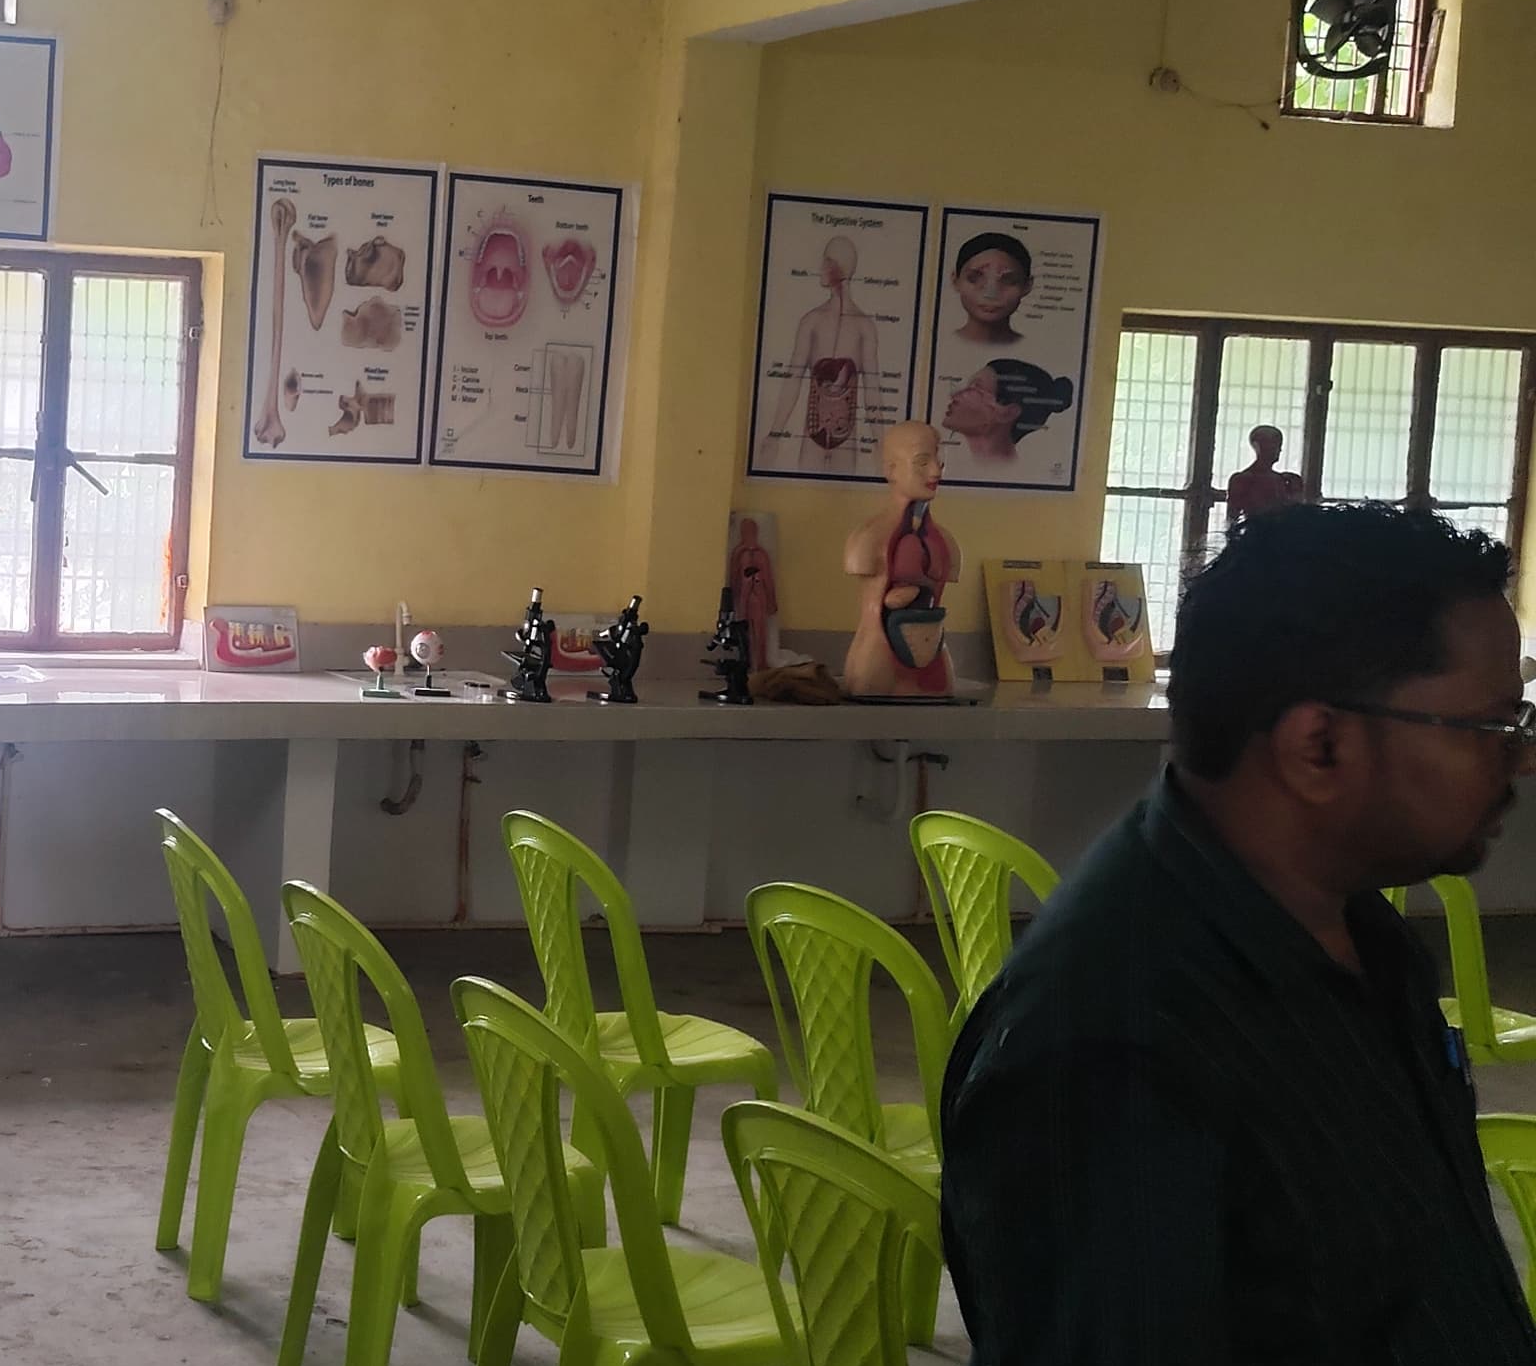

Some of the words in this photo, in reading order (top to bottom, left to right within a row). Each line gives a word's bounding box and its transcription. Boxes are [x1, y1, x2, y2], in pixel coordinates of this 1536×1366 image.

[323, 173, 344, 186] Types
[353, 176, 374, 187] bones
[528, 195, 545, 204] Teeth
[811, 212, 824, 223] The
[825, 214, 858, 227] Digestive
[858, 217, 883, 229] System
